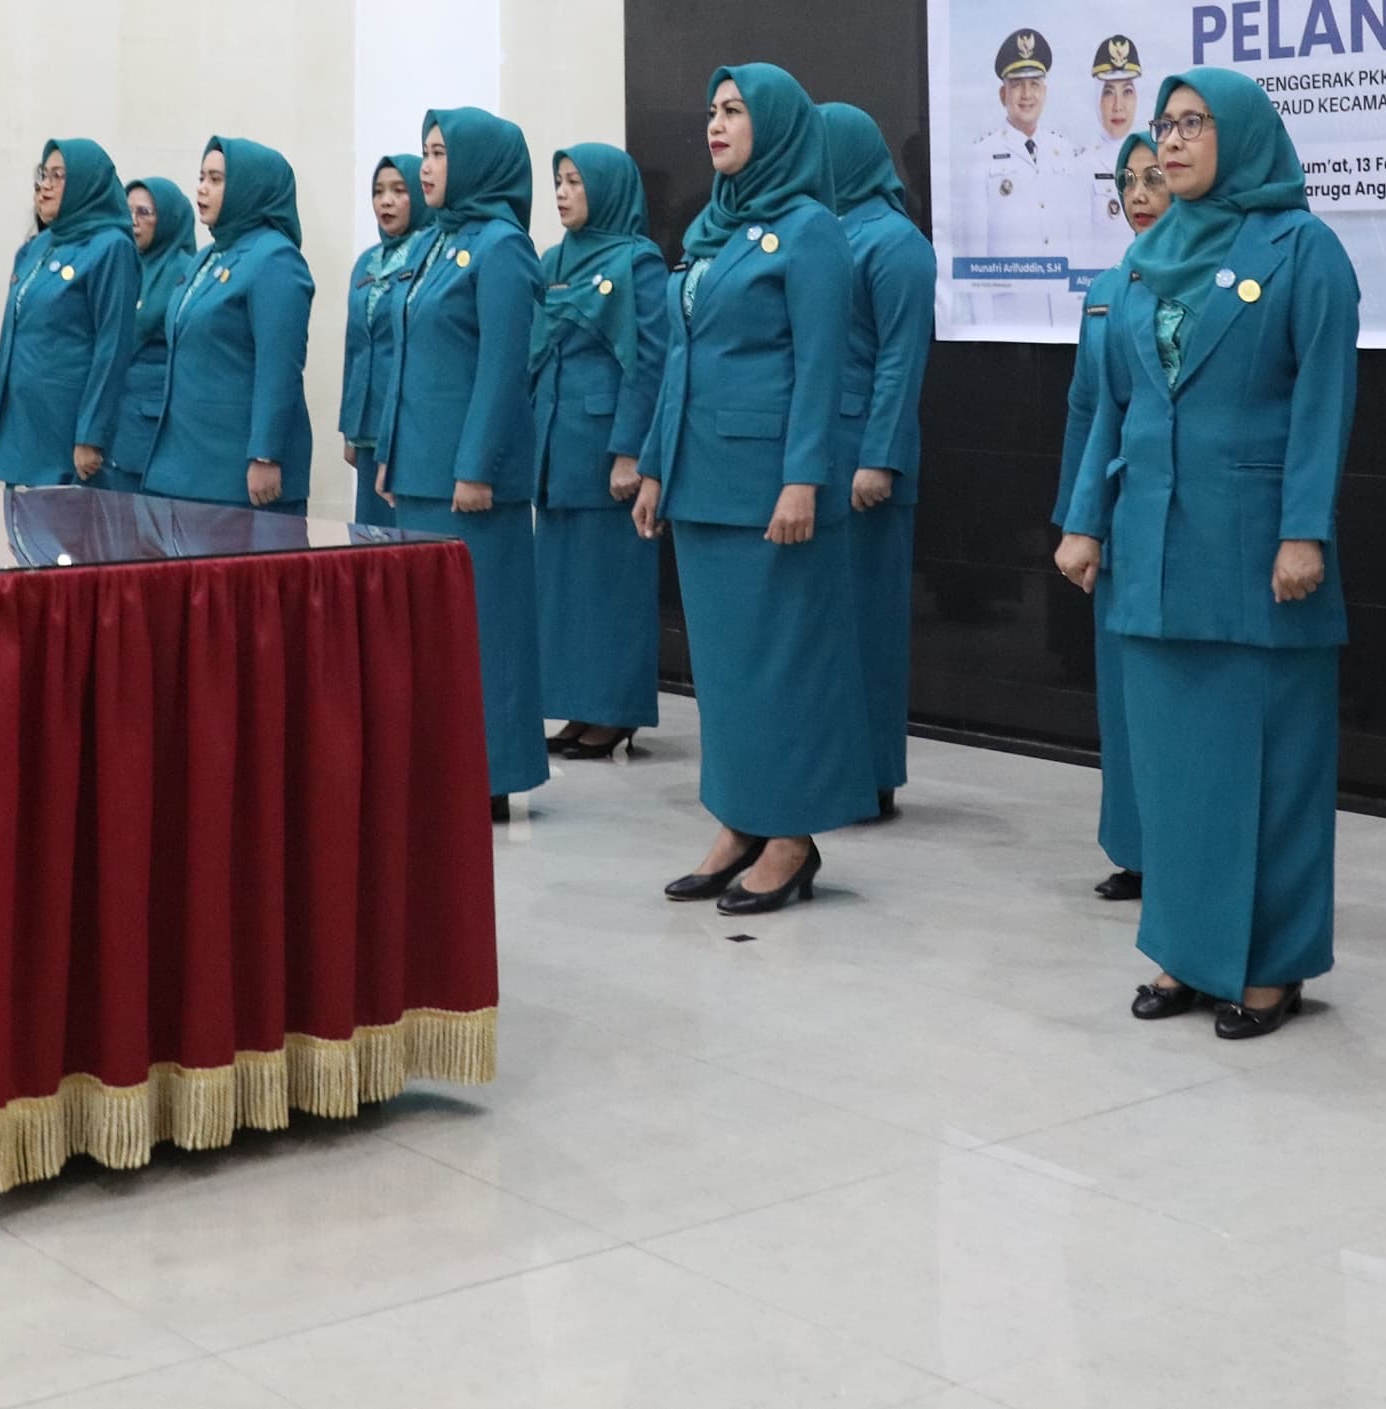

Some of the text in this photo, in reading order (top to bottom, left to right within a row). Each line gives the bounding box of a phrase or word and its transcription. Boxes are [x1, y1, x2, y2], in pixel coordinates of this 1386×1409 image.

[1256, 71, 1354, 92] PENGGERAK
[1302, 158, 1352, 175] um'at,
[1356, 157, 1371, 172] 13
[1305, 183, 1350, 201] aruga
[970, 262, 1002, 273] Munafri
